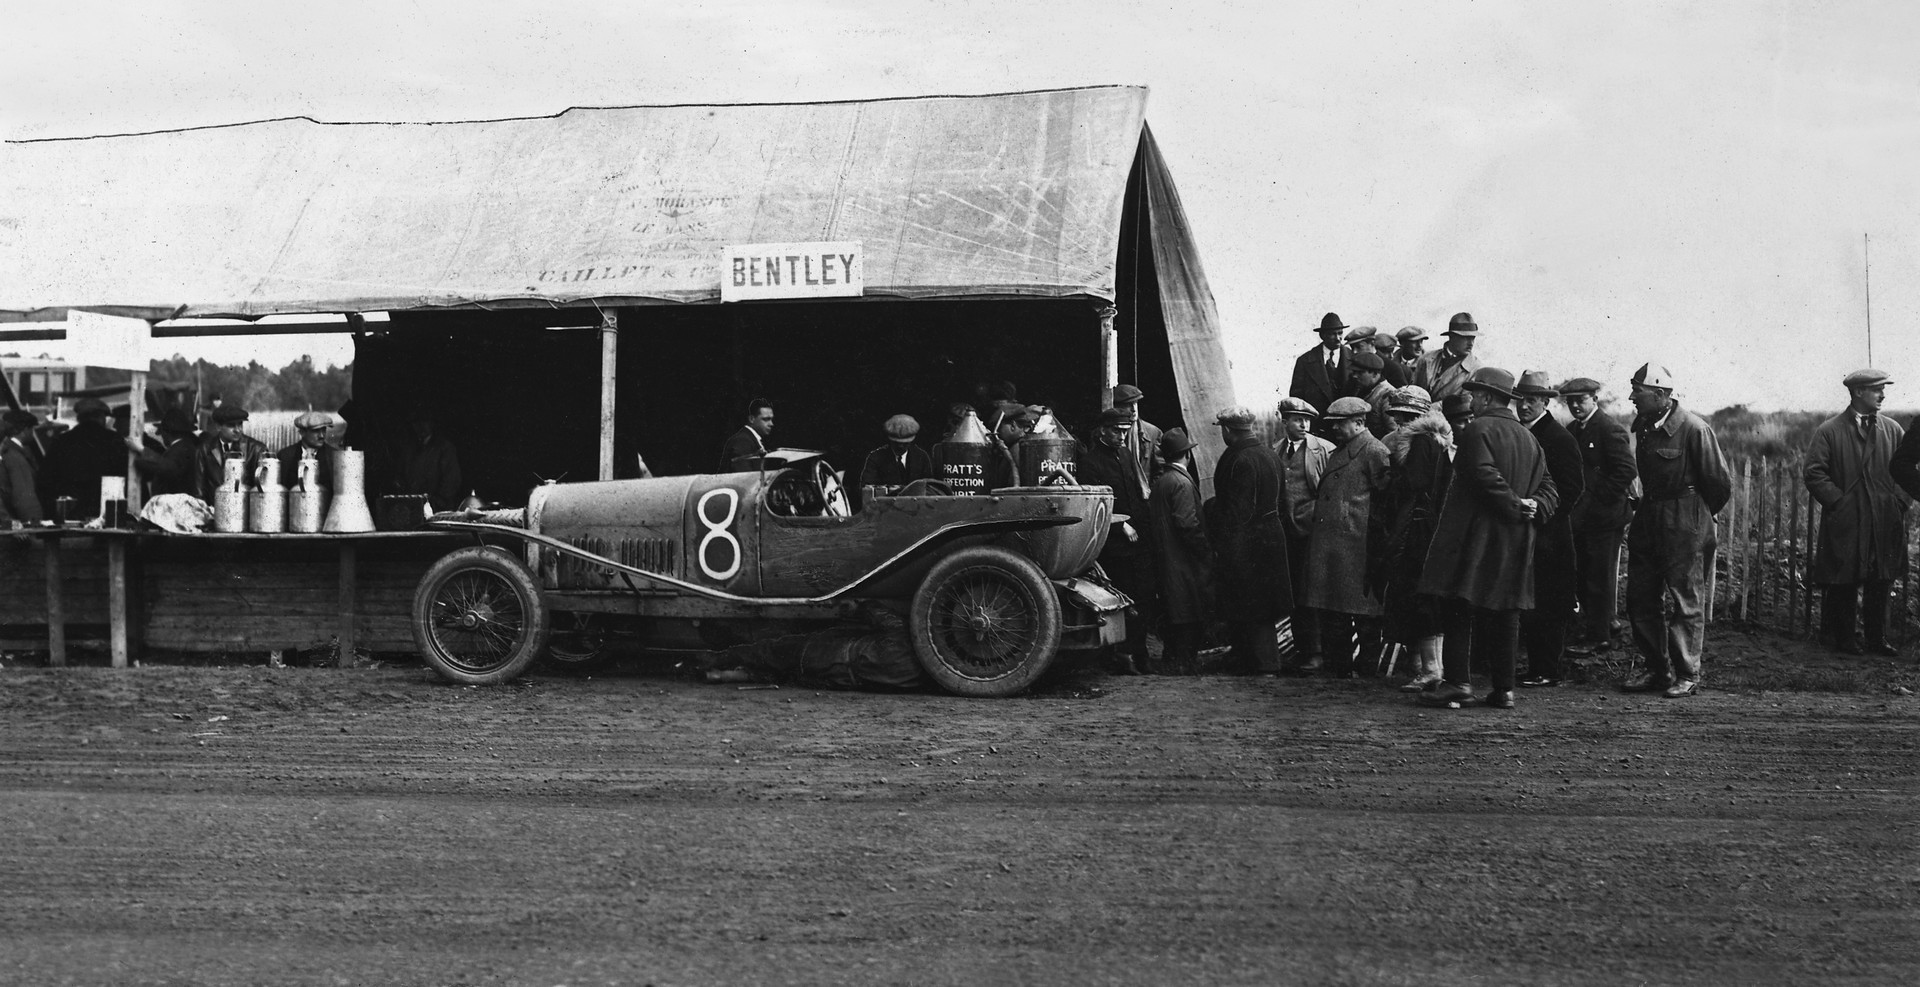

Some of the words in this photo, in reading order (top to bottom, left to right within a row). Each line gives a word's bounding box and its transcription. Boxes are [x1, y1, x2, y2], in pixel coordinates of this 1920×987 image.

[732, 253, 856, 287] BENTLEY
[943, 463, 983, 475] PRATT'S
[697, 487, 741, 580] 8
